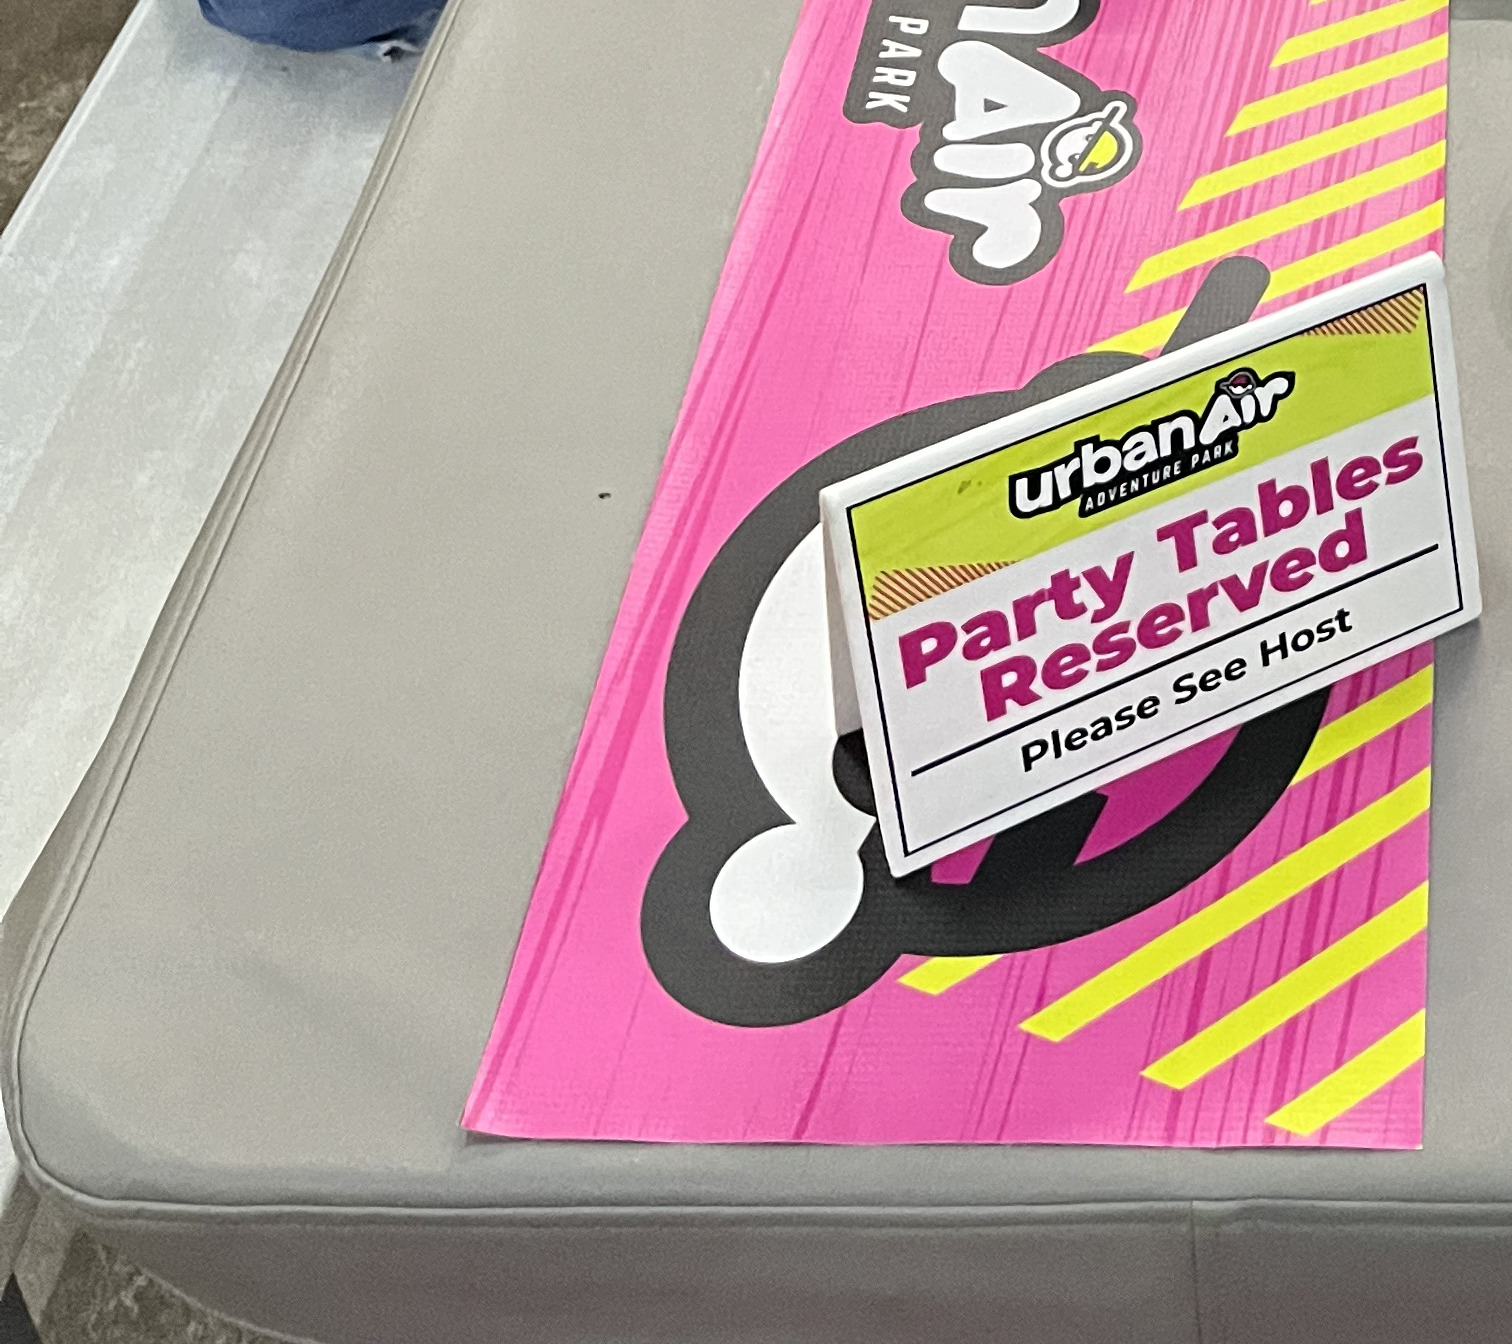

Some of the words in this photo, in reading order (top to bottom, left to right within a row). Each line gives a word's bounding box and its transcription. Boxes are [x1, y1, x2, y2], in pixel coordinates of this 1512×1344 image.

[866, 14, 929, 113] PARK
[1014, 374, 1291, 512] urbanAir
[1084, 460, 1183, 512] ADVENTURE
[1190, 439, 1236, 471] PARK
[899, 550, 1136, 690] Party
[1156, 435, 1425, 574] Tables
[980, 507, 1368, 722] Reserved
[1020, 697, 1160, 773] Please
[1172, 656, 1248, 706] See
[1259, 607, 1354, 670] Host
